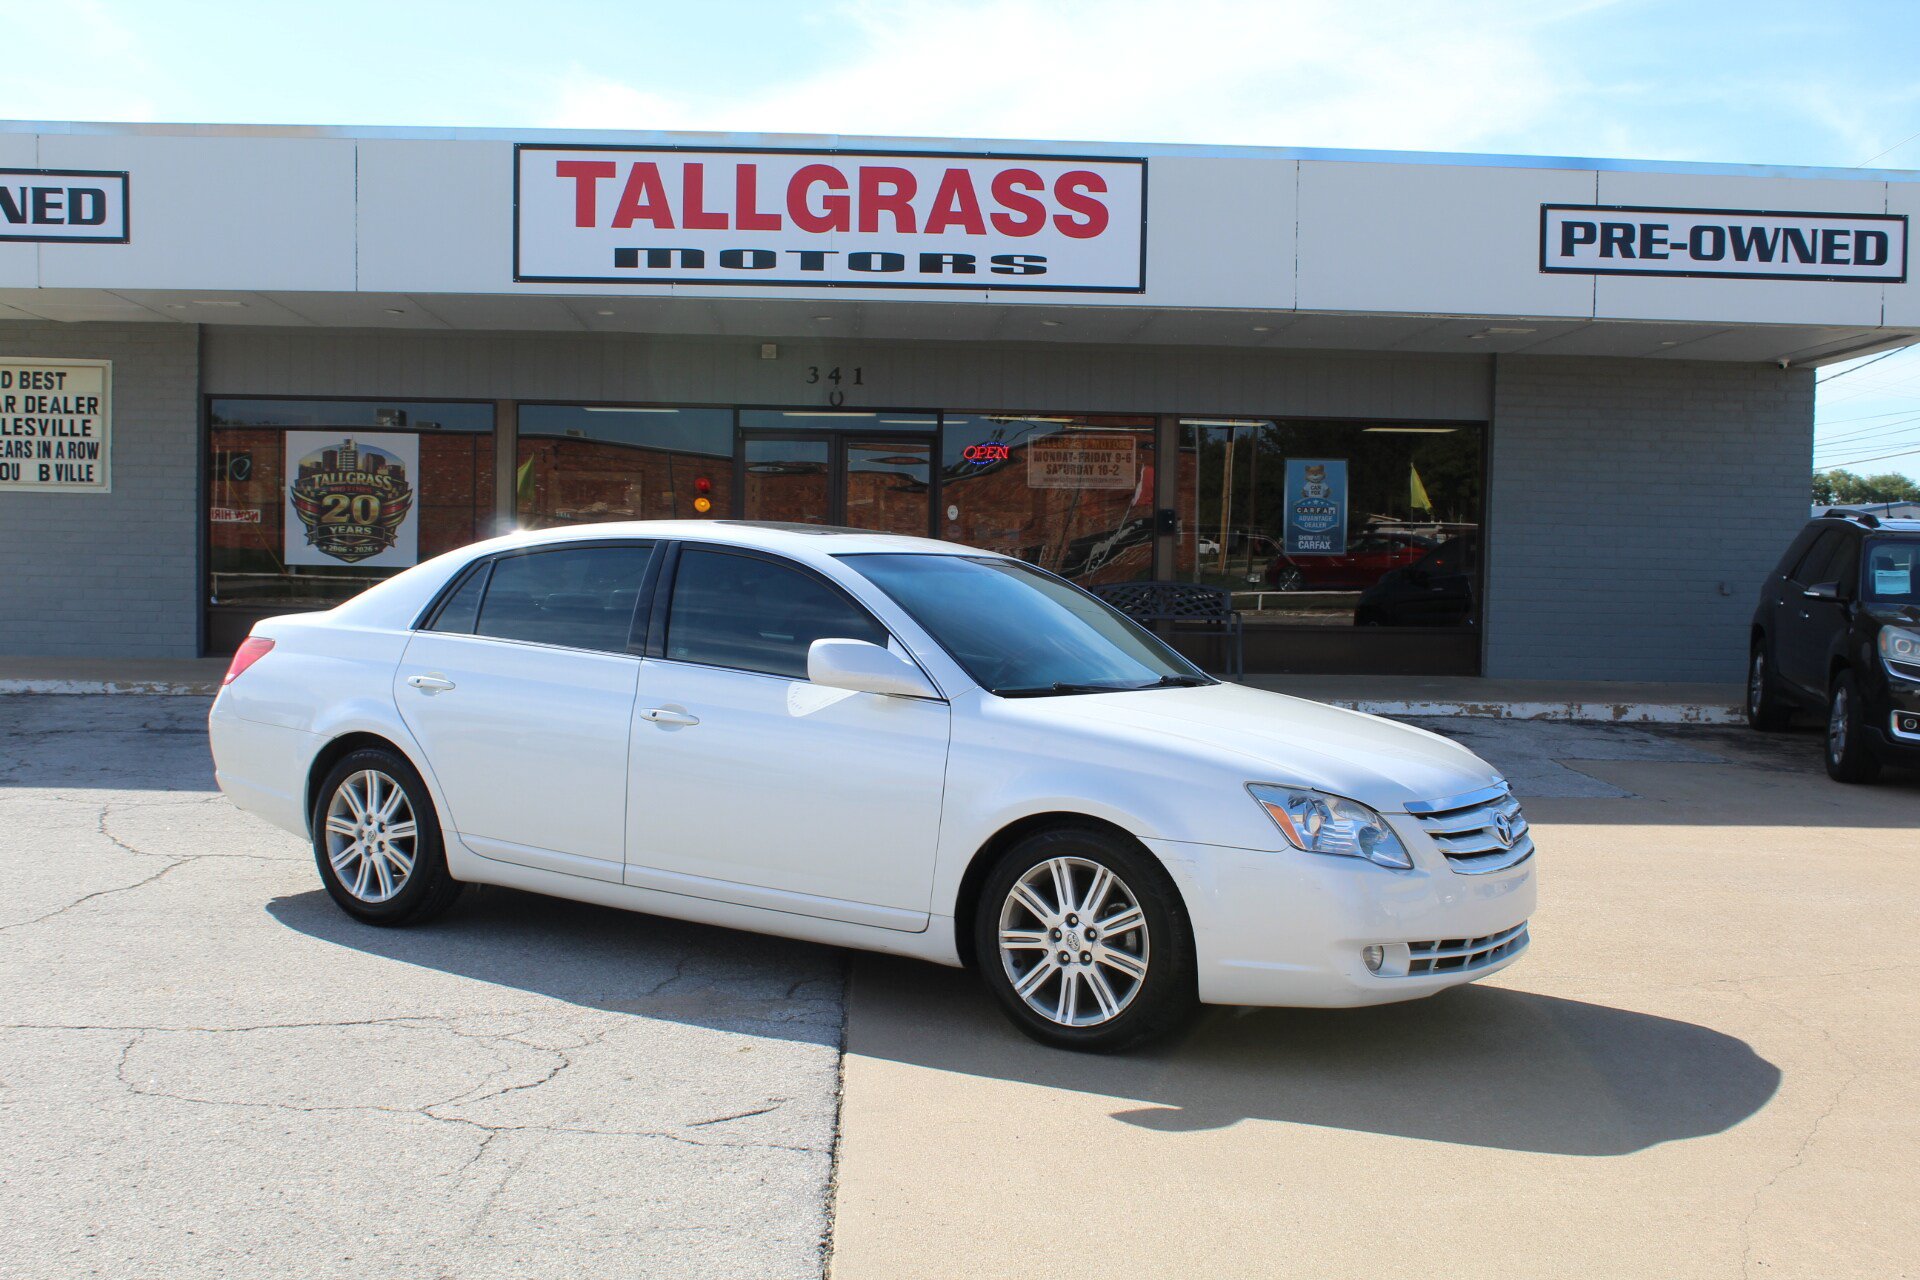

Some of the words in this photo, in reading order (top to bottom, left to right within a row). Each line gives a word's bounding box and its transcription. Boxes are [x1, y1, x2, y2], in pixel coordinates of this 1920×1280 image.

[556, 159, 1109, 240] TALLGRASS
[1560, 220, 1889, 267] PRE-OWNED
[614, 247, 1048, 276] MOTORS
[19, 370, 67, 391] BEST
[0, 395, 16, 414] R
[24, 395, 99, 415] DEALER
[1, 417, 92, 437] LESVILLE
[36, 440, 52, 459] IN
[55, 441, 65, 459] A
[67, 441, 100, 460] ROW
[963, 445, 1010, 460] OPEN
[38, 463, 50, 482] B
[54, 463, 94, 482] VILLE
[1046, 463, 1095, 475] SATURDAY
[311, 471, 393, 492] TALLGRASS
[320, 493, 382, 525] 20
[328, 525, 373, 535] YEARS
[1298, 540, 1331, 550] CARFAX
